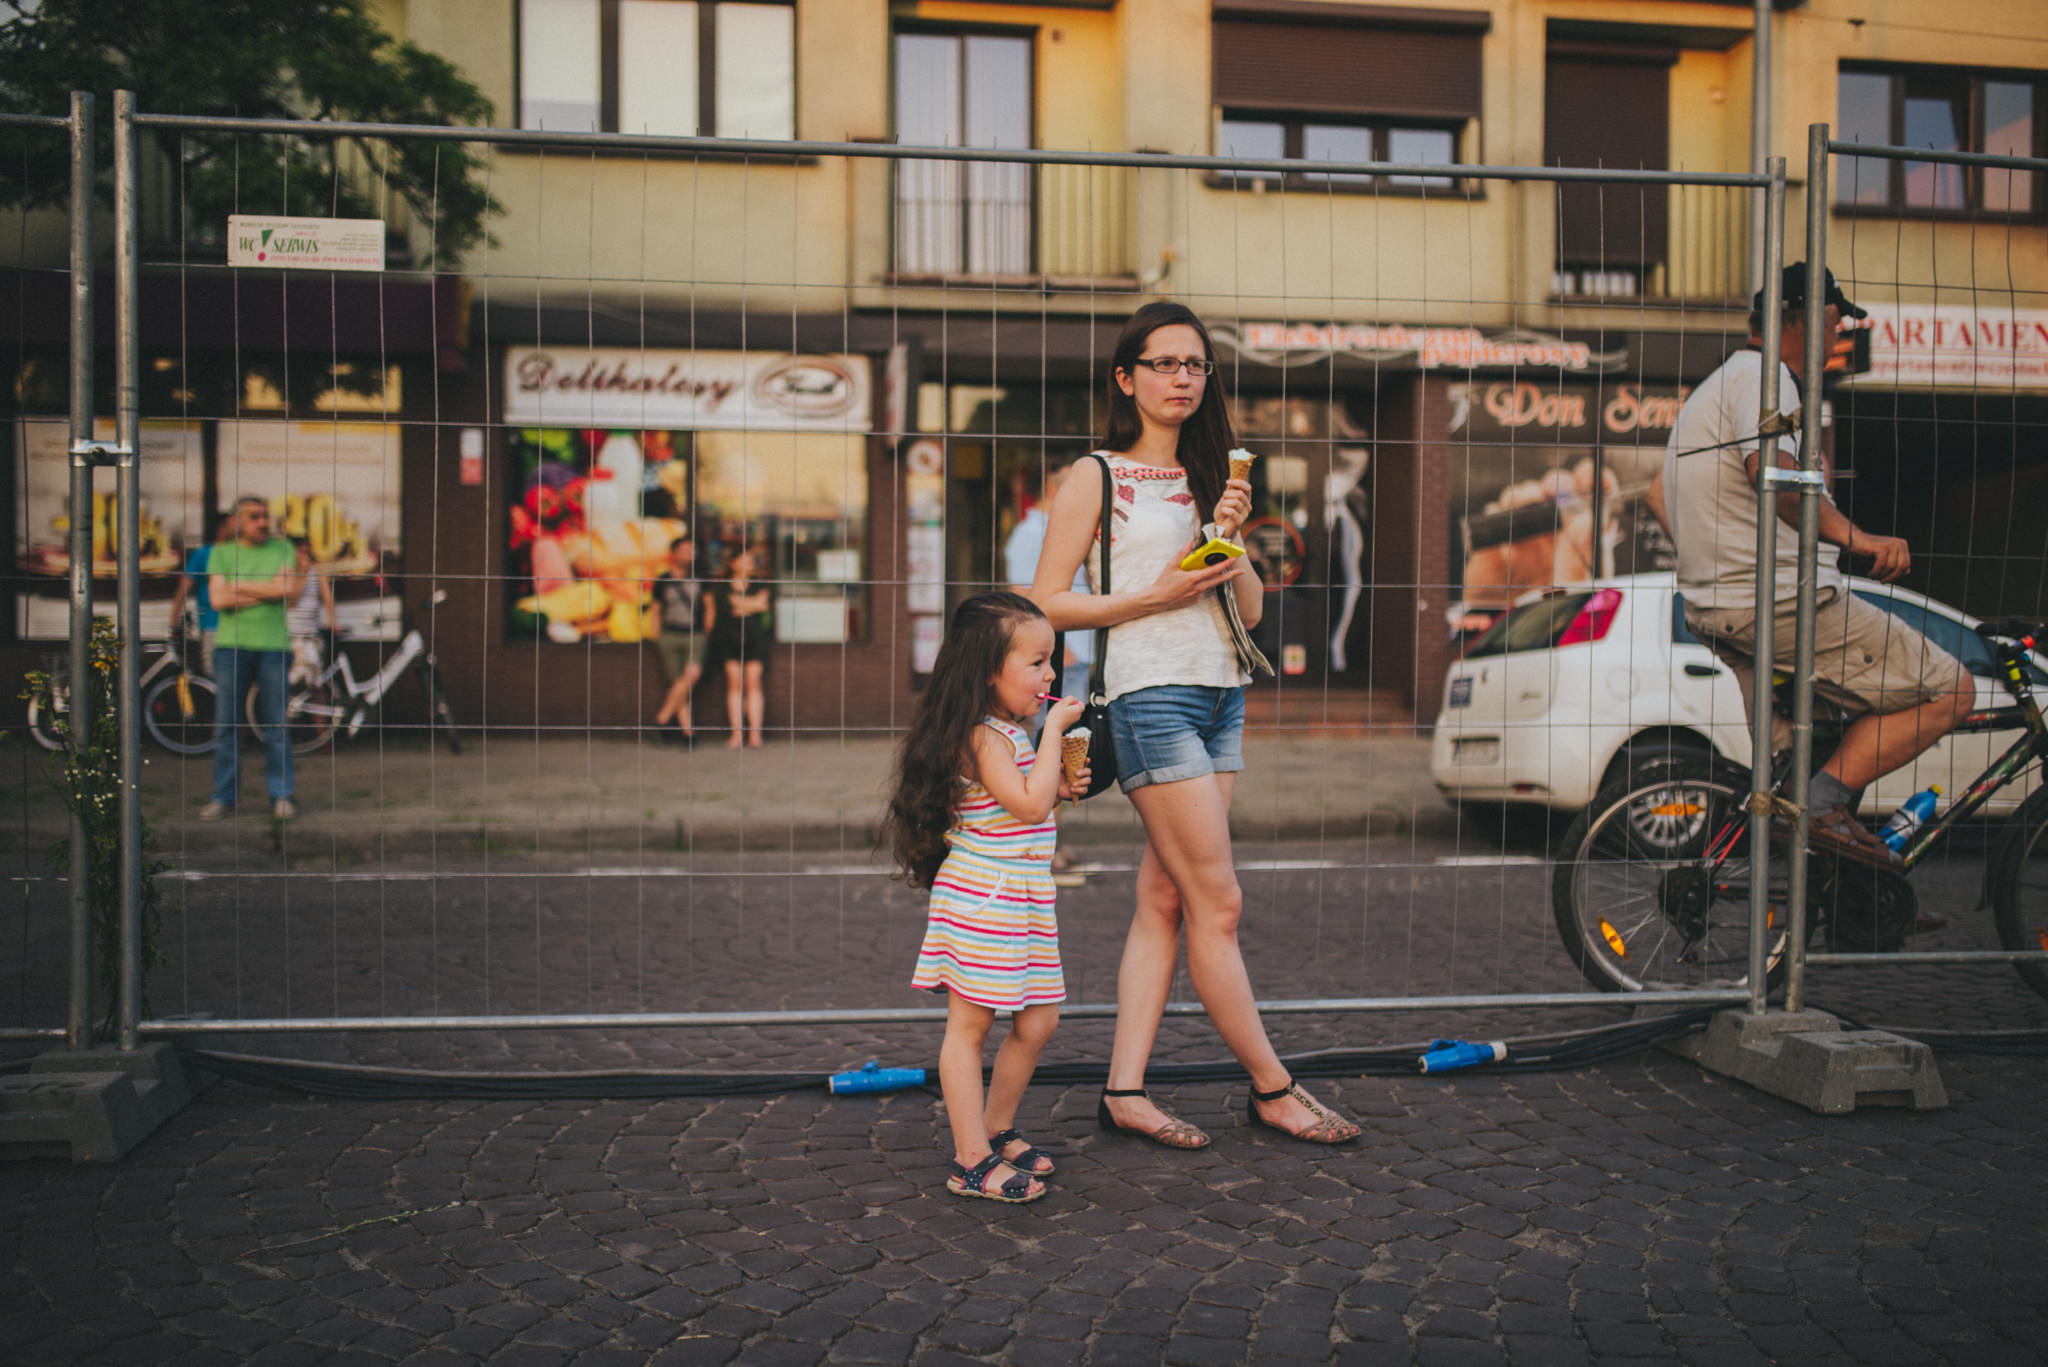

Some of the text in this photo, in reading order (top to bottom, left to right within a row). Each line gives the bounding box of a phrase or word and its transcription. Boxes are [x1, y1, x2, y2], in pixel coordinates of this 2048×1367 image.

[273, 237, 319, 253] SERWIS
[517, 352, 737, 412] Delikatesy
[1485, 382, 1586, 428] Don
